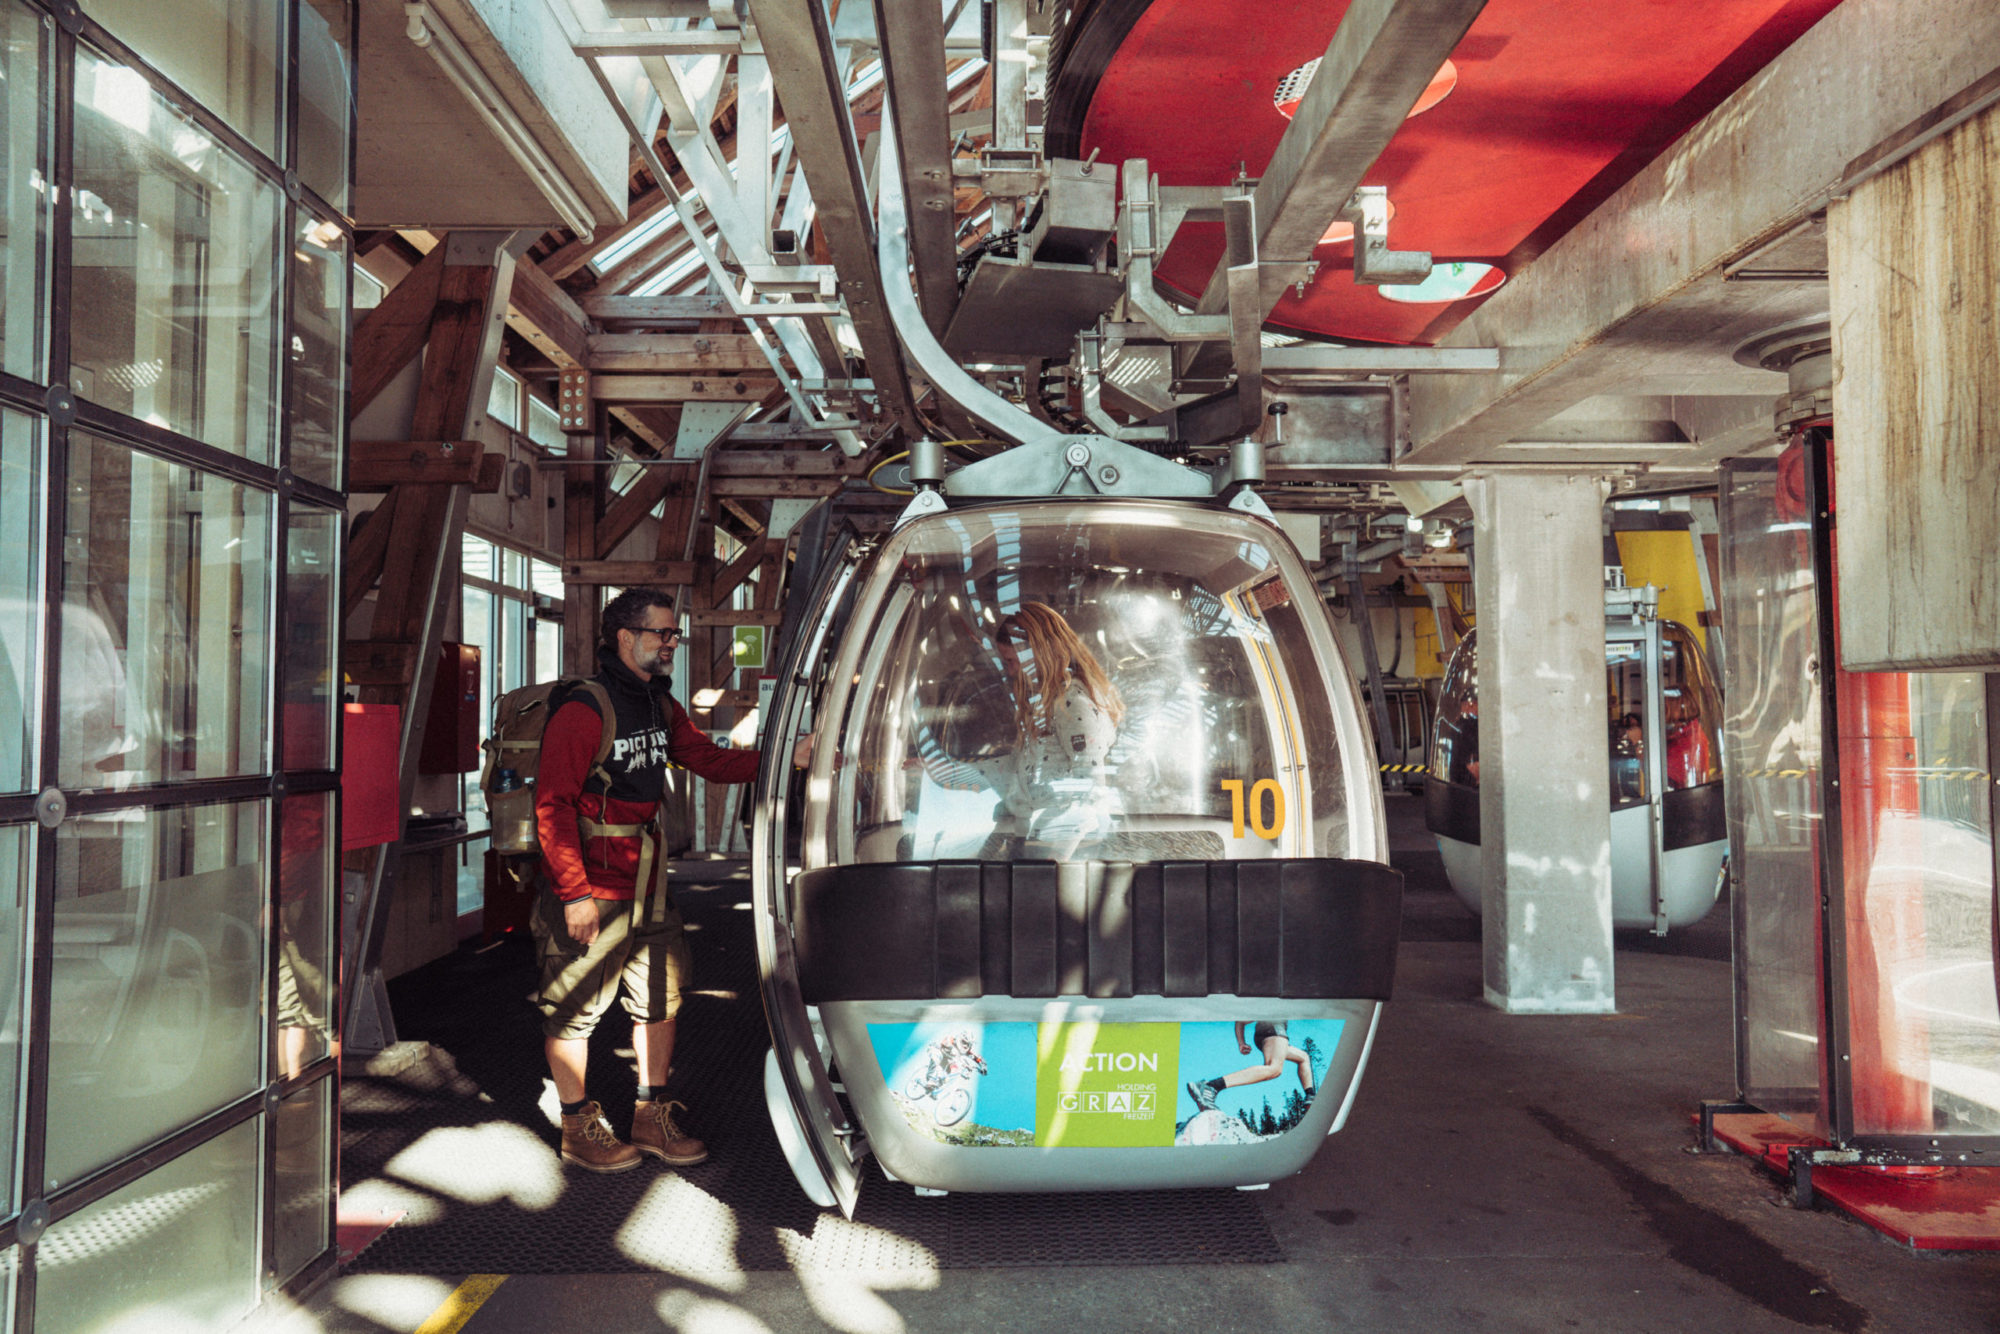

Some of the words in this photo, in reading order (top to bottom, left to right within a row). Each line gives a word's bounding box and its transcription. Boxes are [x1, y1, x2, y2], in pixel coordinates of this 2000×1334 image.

[1221, 778, 1285, 839] 10
[1059, 1052, 1158, 1072] ACTION
[1117, 1083, 1157, 1091] HOLDING
[1060, 1092, 1153, 1111] GRAZ
